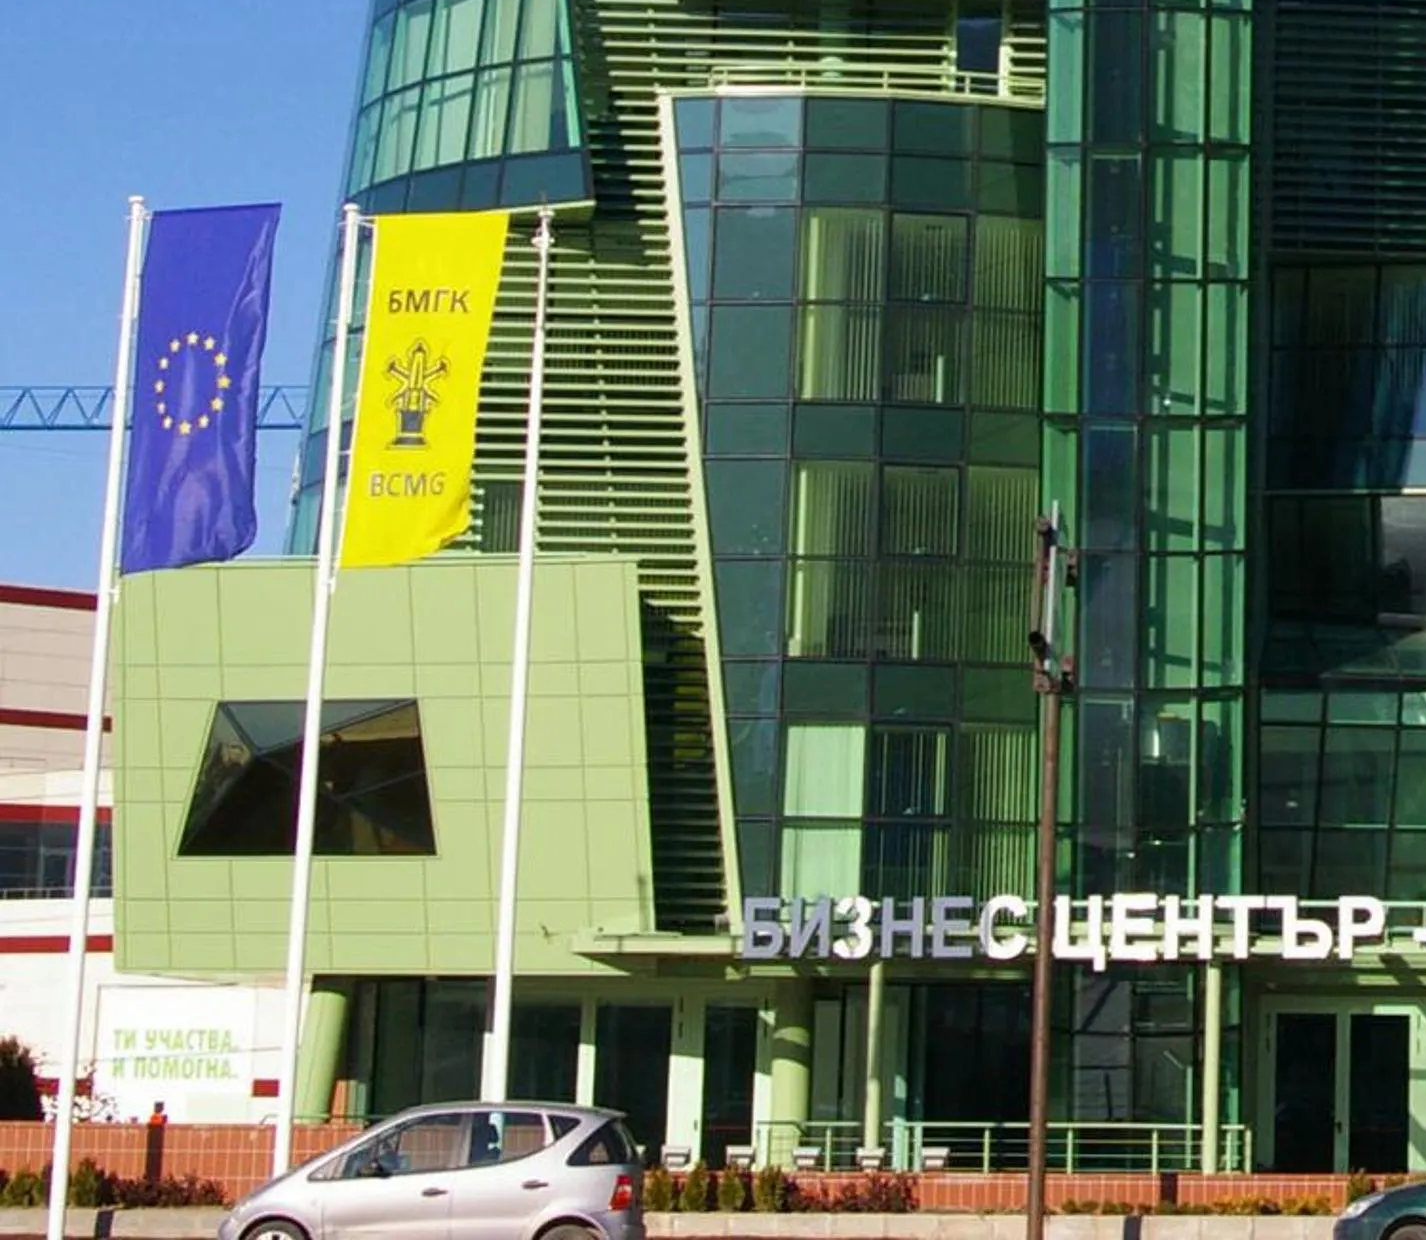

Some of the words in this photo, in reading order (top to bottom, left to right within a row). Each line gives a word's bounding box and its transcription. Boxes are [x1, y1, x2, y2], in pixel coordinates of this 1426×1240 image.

[388, 289, 470, 314] БМГК
[370, 472, 446, 497] BCMG
[743, 895, 1028, 960] БИЗНЕС
[1053, 893, 1386, 972] ЦЕНТЪР
[113, 1030, 137, 1050] ТИ
[112, 1058, 125, 1078] И
